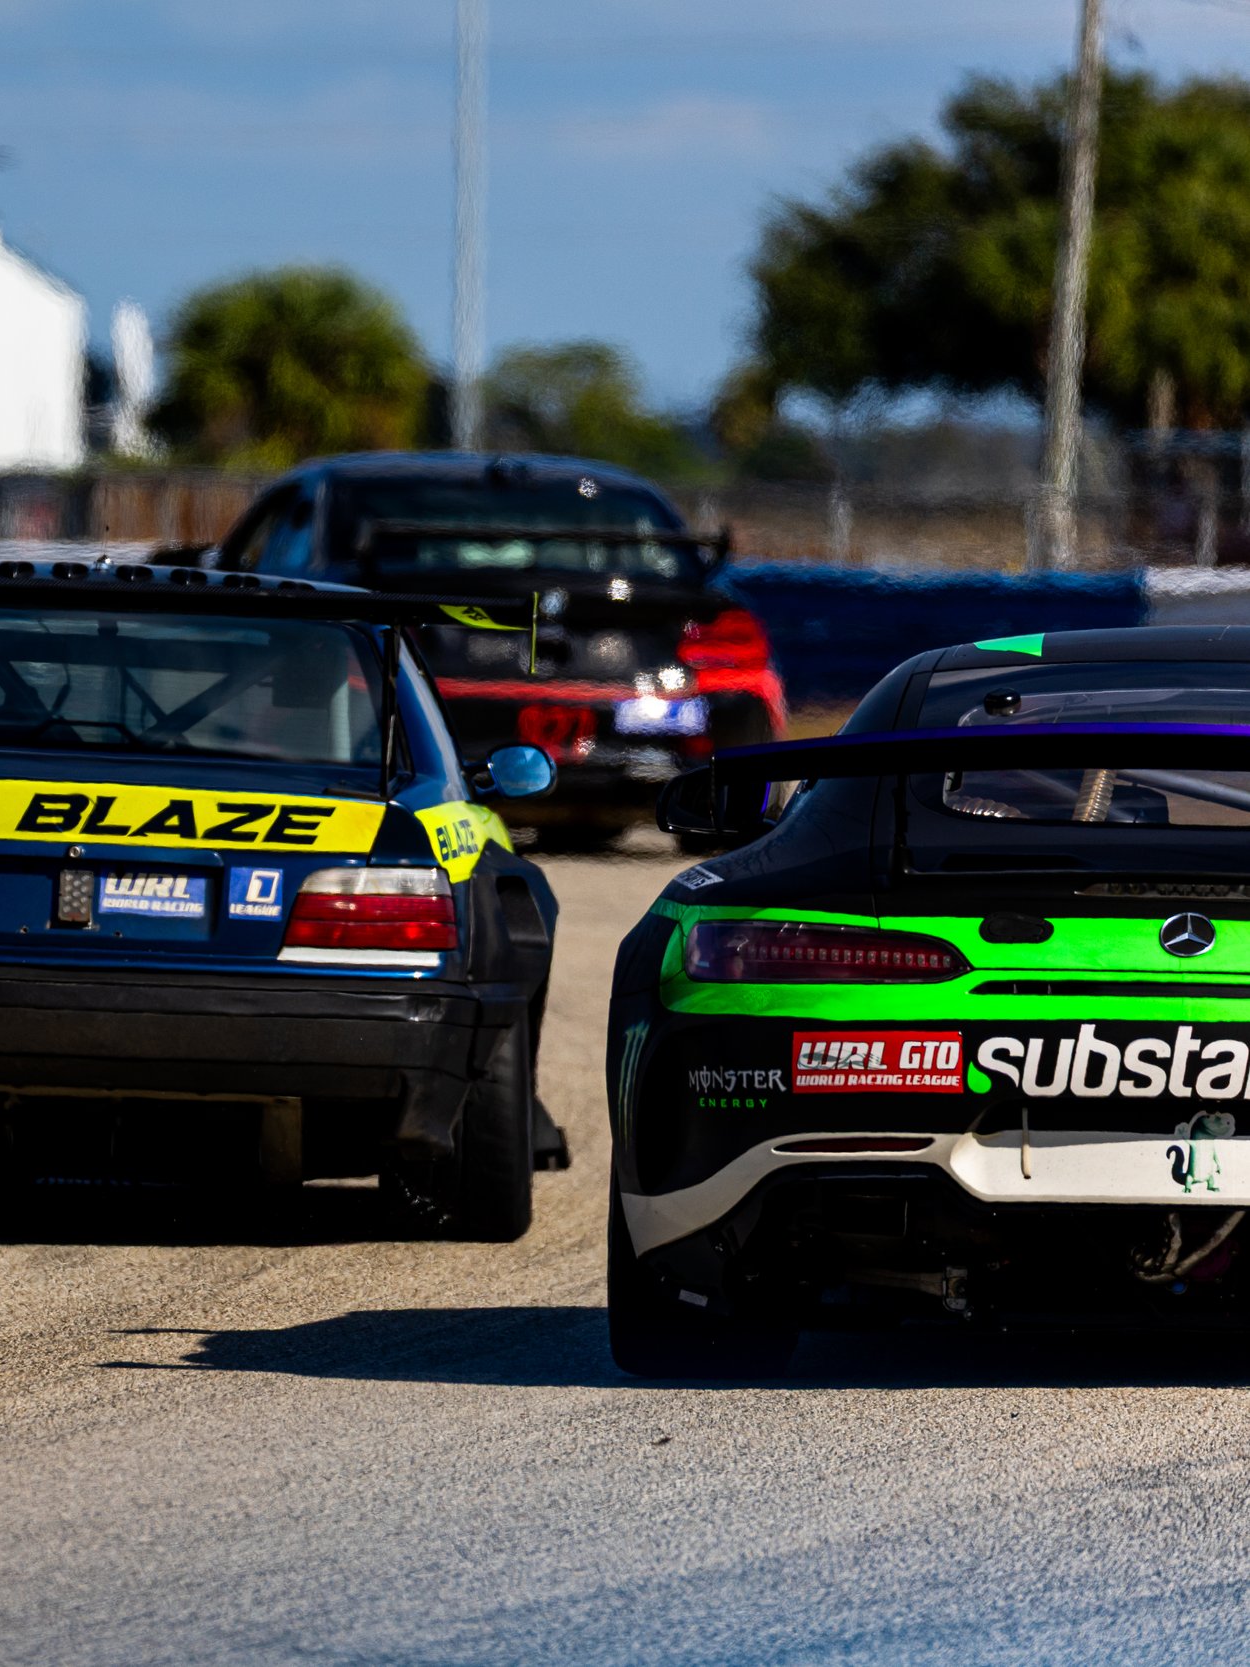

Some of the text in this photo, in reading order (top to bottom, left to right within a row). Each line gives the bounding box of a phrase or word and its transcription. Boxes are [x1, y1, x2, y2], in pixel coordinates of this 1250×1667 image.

[15, 793, 336, 845] BLAZE
[436, 819, 479, 862] BLAZE
[104, 872, 190, 898] WRL
[152, 900, 204, 913] RACING
[229, 903, 282, 916] LEAGUE
[797, 1040, 960, 1070] WRL GTO
[689, 1065, 787, 1093] MONSTER
[796, 1074, 961, 1087] WORLD RACING LEAGUE
[699, 1097, 768, 1108] ENERGY
